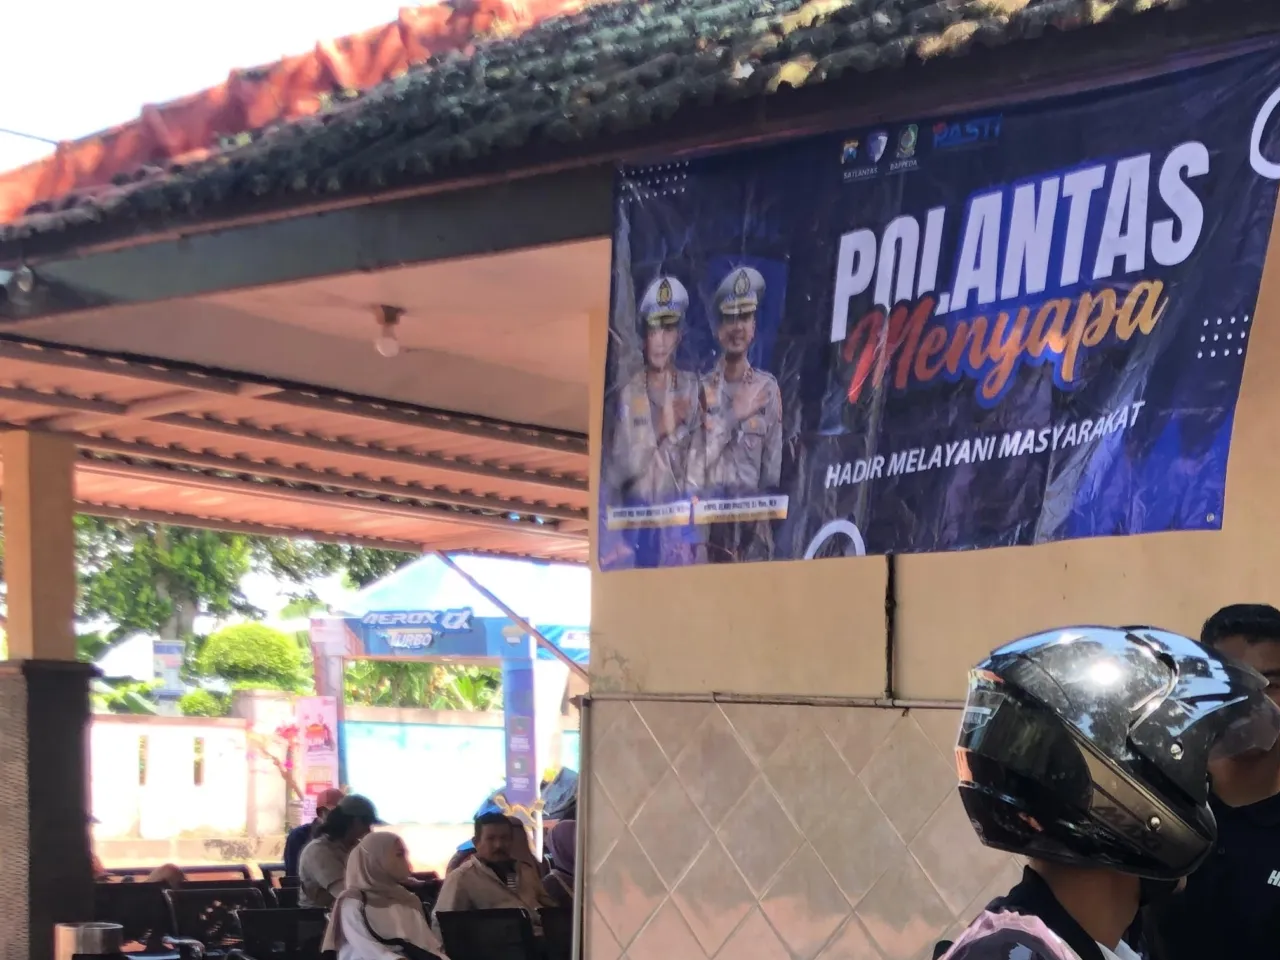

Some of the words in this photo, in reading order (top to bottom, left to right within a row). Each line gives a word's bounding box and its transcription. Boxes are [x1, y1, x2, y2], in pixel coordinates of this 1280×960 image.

[830, 140, 1210, 343] POLANTAS
[844, 279, 1169, 404] Menyapa
[825, 453, 886, 489] HADIR
[887, 435, 997, 477] MELAYANI
[998, 400, 1146, 459] MASYARAKAT
[362, 611, 440, 625] AEROX
[388, 630, 433, 648] TURBO
